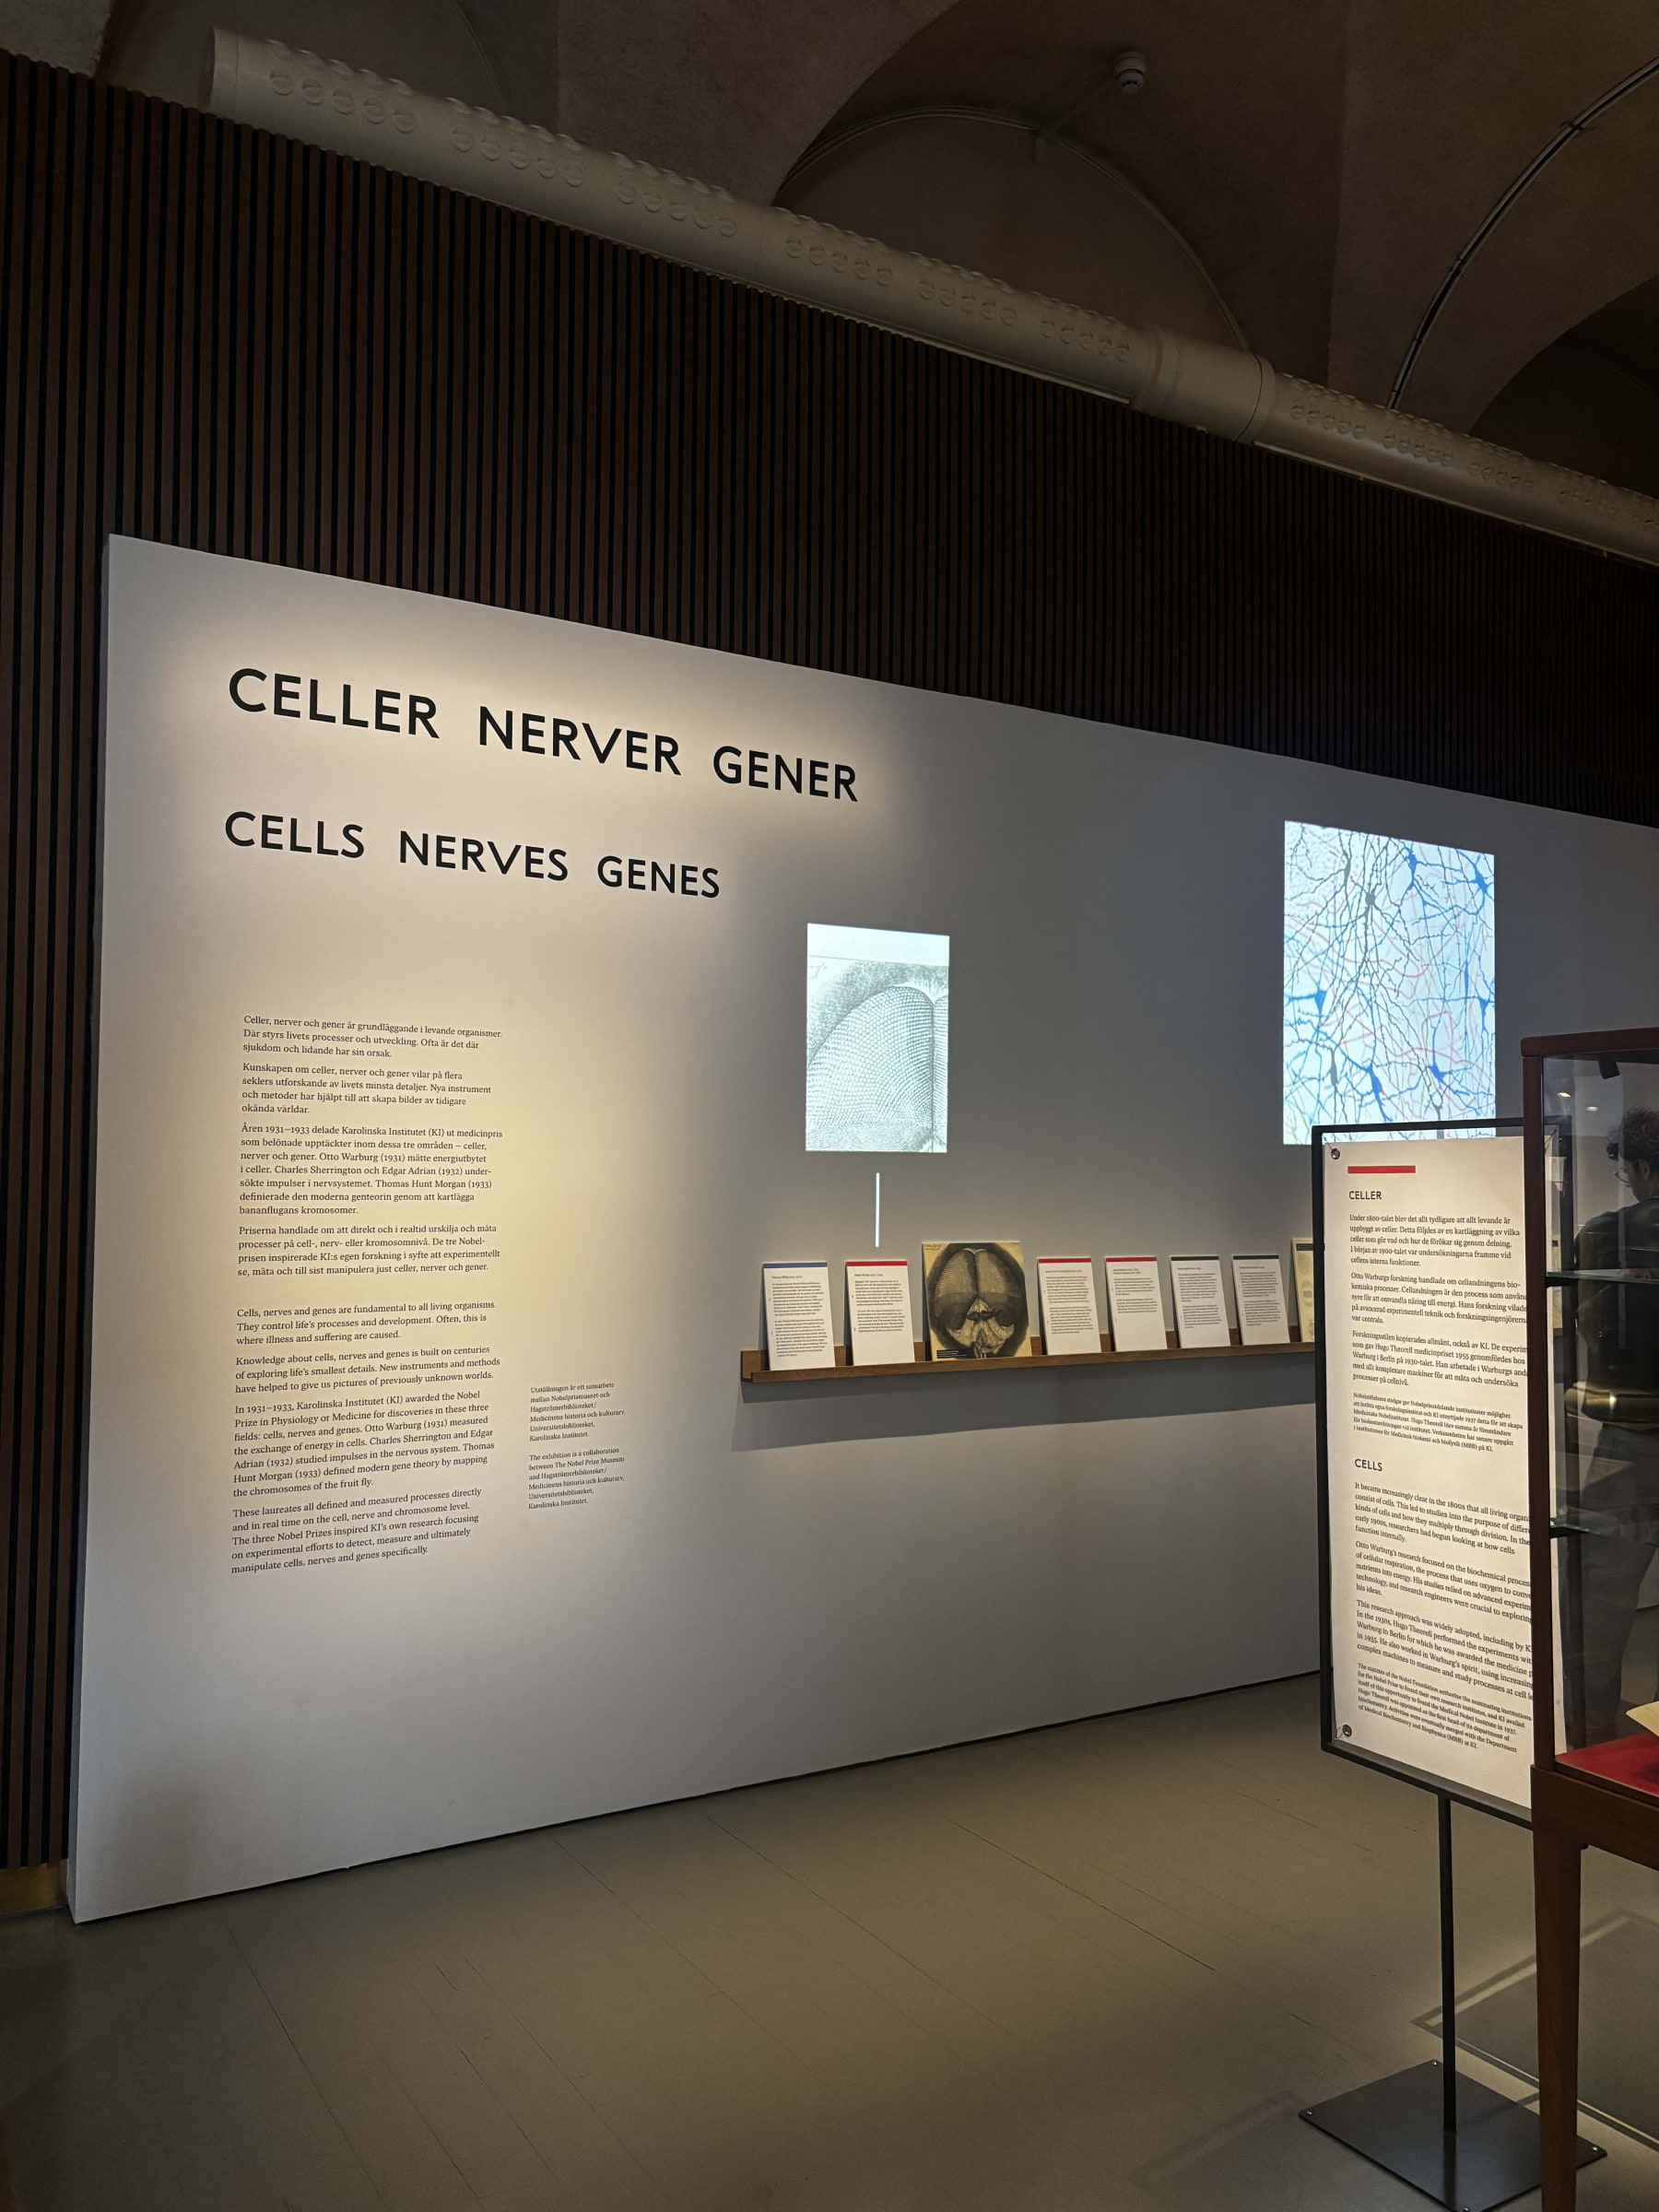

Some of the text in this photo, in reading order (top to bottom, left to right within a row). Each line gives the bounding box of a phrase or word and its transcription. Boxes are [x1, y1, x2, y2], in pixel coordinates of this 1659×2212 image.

[229, 668, 858, 803] CELLER NERVER GENER
[225, 811, 720, 899] CELLS NERVES GENES
[244, 1014, 271, 1027] Celler,
[303, 1018, 319, 1027] och
[321, 1021, 345, 1030] gener
[346, 1021, 356, 1029] är
[357, 1022, 418, 1034] grundläggande
[419, 1025, 422, 1033] i
[424, 1024, 455, 1035] levande
[456, 1028, 502, 1038] organismer.
[244, 1028, 479, 1049] Där styrs livets processer och utveckling. Ofta är det där
[243, 1042, 392, 1057] sjukdom och lidande har sin orsak.
[241, 1120, 263, 1132] Åren
[311, 1124, 339, 1134] delade
[341, 1125, 386, 1135] Karolinska
[388, 1126, 426, 1136] Institutet
[428, 1127, 444, 1138] (KI)
[446, 1128, 454, 1137] ut
[456, 1128, 503, 1140] medicinpris
[1348, 1190, 1382, 1200] CELLER
[1429, 1216, 1454, 1224] tydligare
[238, 1269, 250, 1278] se,
[252, 1267, 274, 1275] mäta
[275, 1266, 292, 1275] och
[294, 1265, 306, 1274] till
[308, 1266, 323, 1274] sist
[326, 1264, 374, 1275] manipulera
[376, 1264, 392, 1275] just
[393, 1263, 418, 1274] celler,
[448, 1262, 463, 1271] och
[464, 1264, 489, 1273] gener.
[237, 1308, 261, 1318] Cells,
[293, 1306, 310, 1315] and
[311, 1307, 336, 1317] genes
[353, 1302, 406, 1313] fundamental
[407, 1303, 416, 1311] to
[418, 1302, 428, 1311] all
[429, 1301, 452, 1312] living
[453, 1300, 496, 1311] organisms.
[237, 1322, 259, 1332] They
[261, 1320, 293, 1330] control
[317, 1320, 359, 1330] processes
[360, 1317, 376, 1326] and
[378, 1315, 433, 1326] development.
[435, 1314, 461, 1324] Often,
[463, 1313, 478, 1322] this
[479, 1313, 486, 1321] is
[236, 1335, 264, 1345] where
[265, 1334, 294, 1343] illness
[295, 1333, 312, 1342] and
[313, 1332, 352, 1342] suffering
[368, 1329, 401, 1339] caused.
[235, 1405, 244, 1414] In
[296, 1399, 343, 1410] Karolinska
[344, 1396, 384, 1407] Institutet
[385, 1394, 403, 1406] (KI)
[404, 1392, 440, 1403] awarded
[441, 1391, 455, 1400] the
[456, 1389, 480, 1399] Nobel
[582, 1447, 619, 1456] collaboration
[541, 1466, 607, 1480] Hagströmerbiblioteket/
[1354, 1458, 1382, 1471] CELLS
[528, 1500, 559, 1509] Karolinska
[1360, 1483, 1380, 1493] became
[1414, 1494, 1427, 1502] clear
[1447, 1500, 1465, 1509] 1800s
[1466, 1504, 1479, 1512] that
[1490, 1508, 1508, 1519] living
[1355, 1524, 1379, 1535] function
[1355, 1516, 1369, 1524] early
[1388, 1523, 1418, 1533] researchers
[1432, 1531, 1450, 1540] begun
[1452, 1535, 1475, 1547] looking
[1484, 1542, 1498, 1550] how
[231, 1545, 428, 1573] manipulate cells, nerves and genes specifically.
